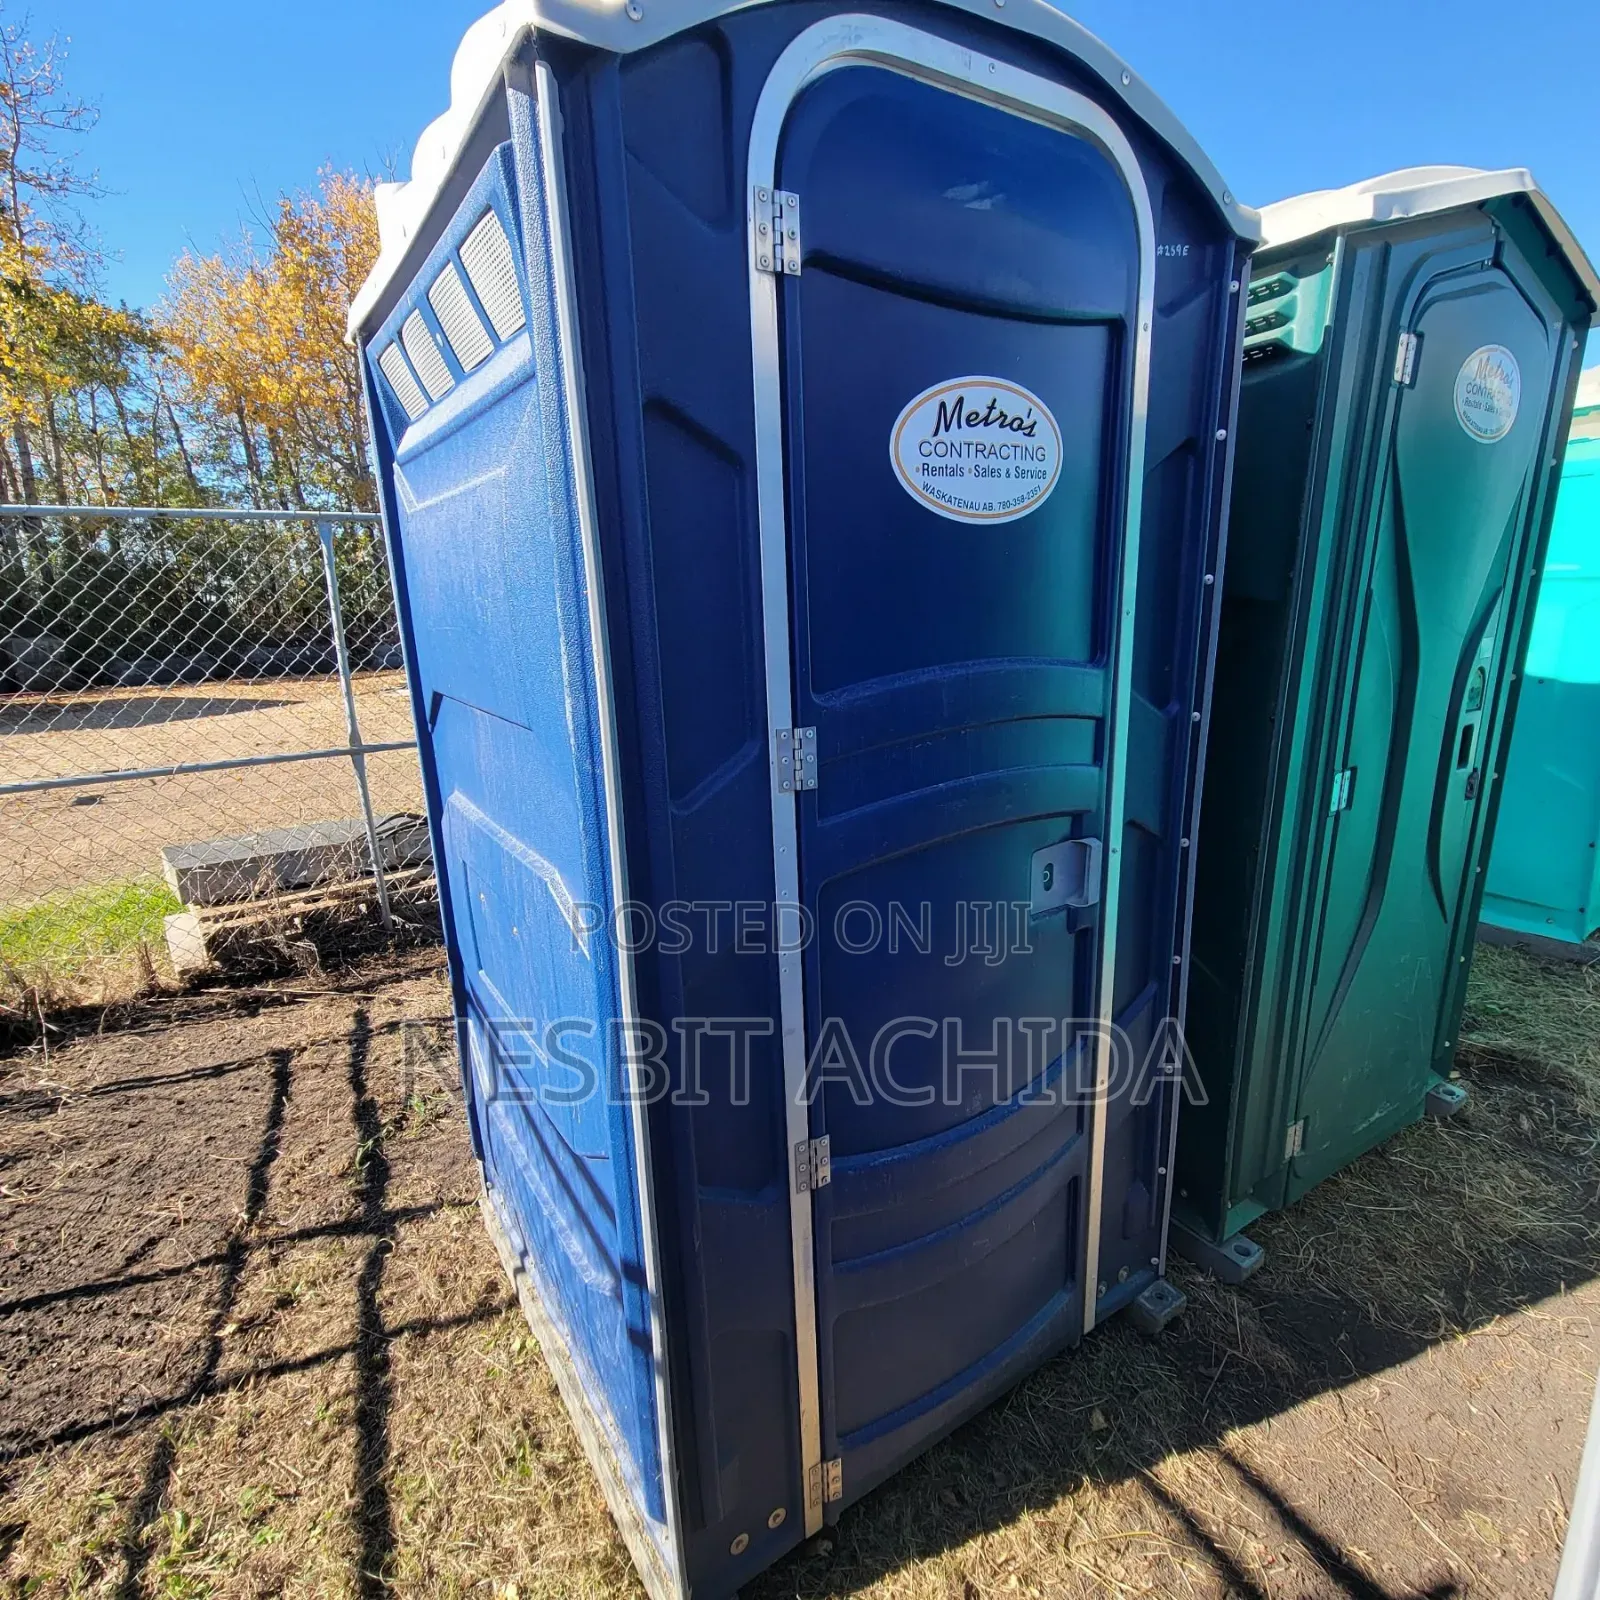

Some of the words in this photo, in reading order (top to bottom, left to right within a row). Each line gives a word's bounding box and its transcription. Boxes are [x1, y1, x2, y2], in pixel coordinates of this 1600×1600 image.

[932, 395, 1038, 438] Metro's
[918, 440, 1047, 462] CONTRACTING
[921, 462, 965, 477] Rentals
[973, 464, 1002, 479] Sales
[1005, 469, 1012, 479] &
[1014, 465, 1047, 480] Service
[922, 481, 981, 511] WASKATENAU
